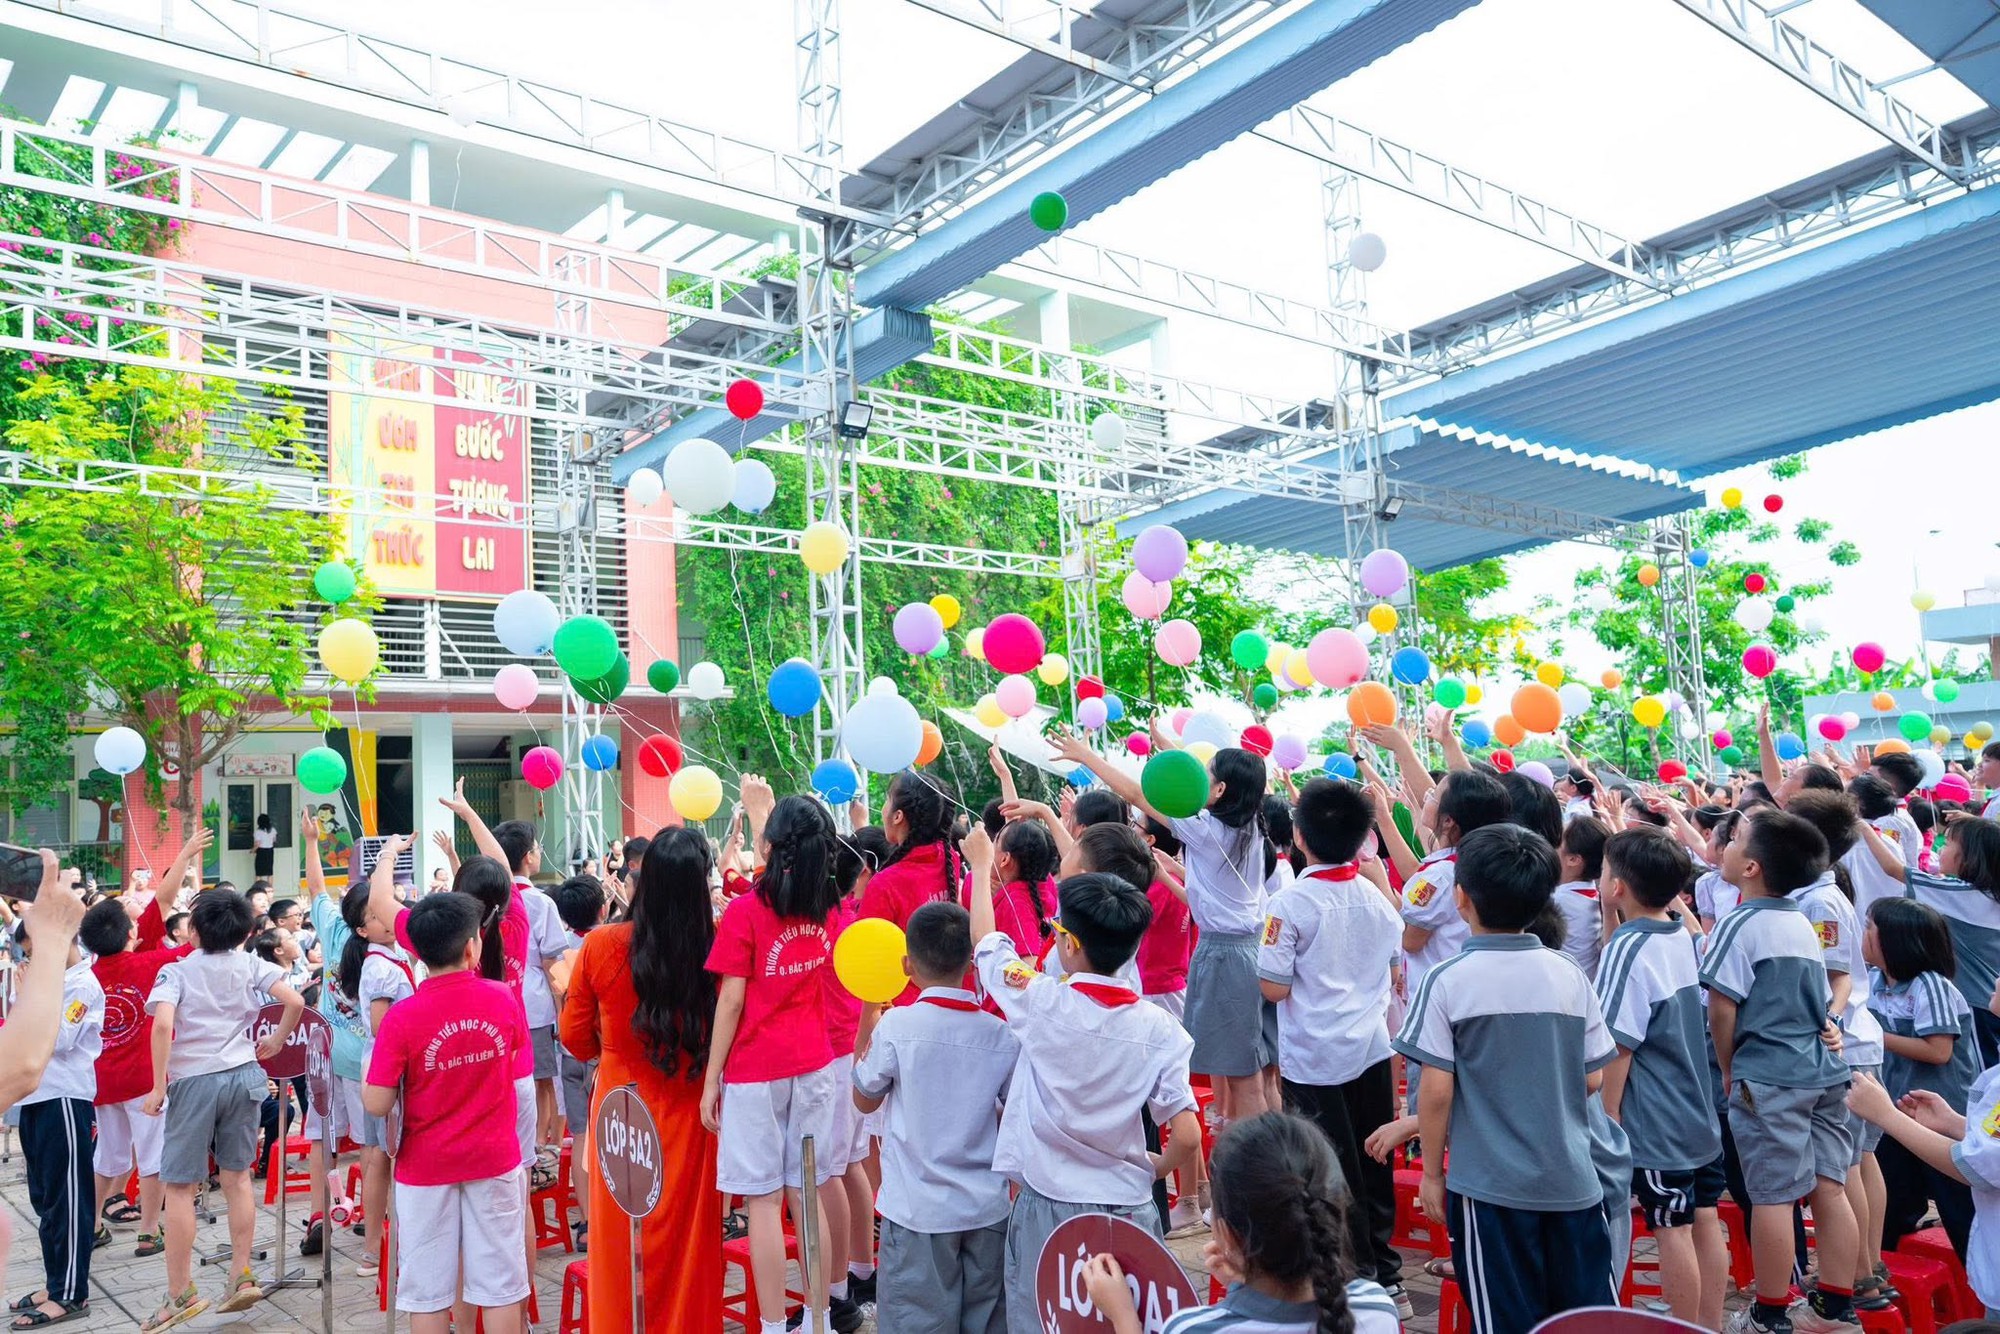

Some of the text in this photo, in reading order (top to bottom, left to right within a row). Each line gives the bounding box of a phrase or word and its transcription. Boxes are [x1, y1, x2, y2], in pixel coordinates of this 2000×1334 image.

[455, 418, 504, 462] BƯỚC
[448, 474, 510, 518] TƯƠNG
[461, 535, 496, 571] LAI
[799, 923, 817, 938] HỌC
[424, 1037, 443, 1072] TRƯỜNG
[438, 1021, 459, 1040] TIỂU
[459, 1018, 480, 1032] HỌC
[604, 1108, 653, 1170] LỚP 5A2
[1058, 1242, 1103, 1322] LỚ
